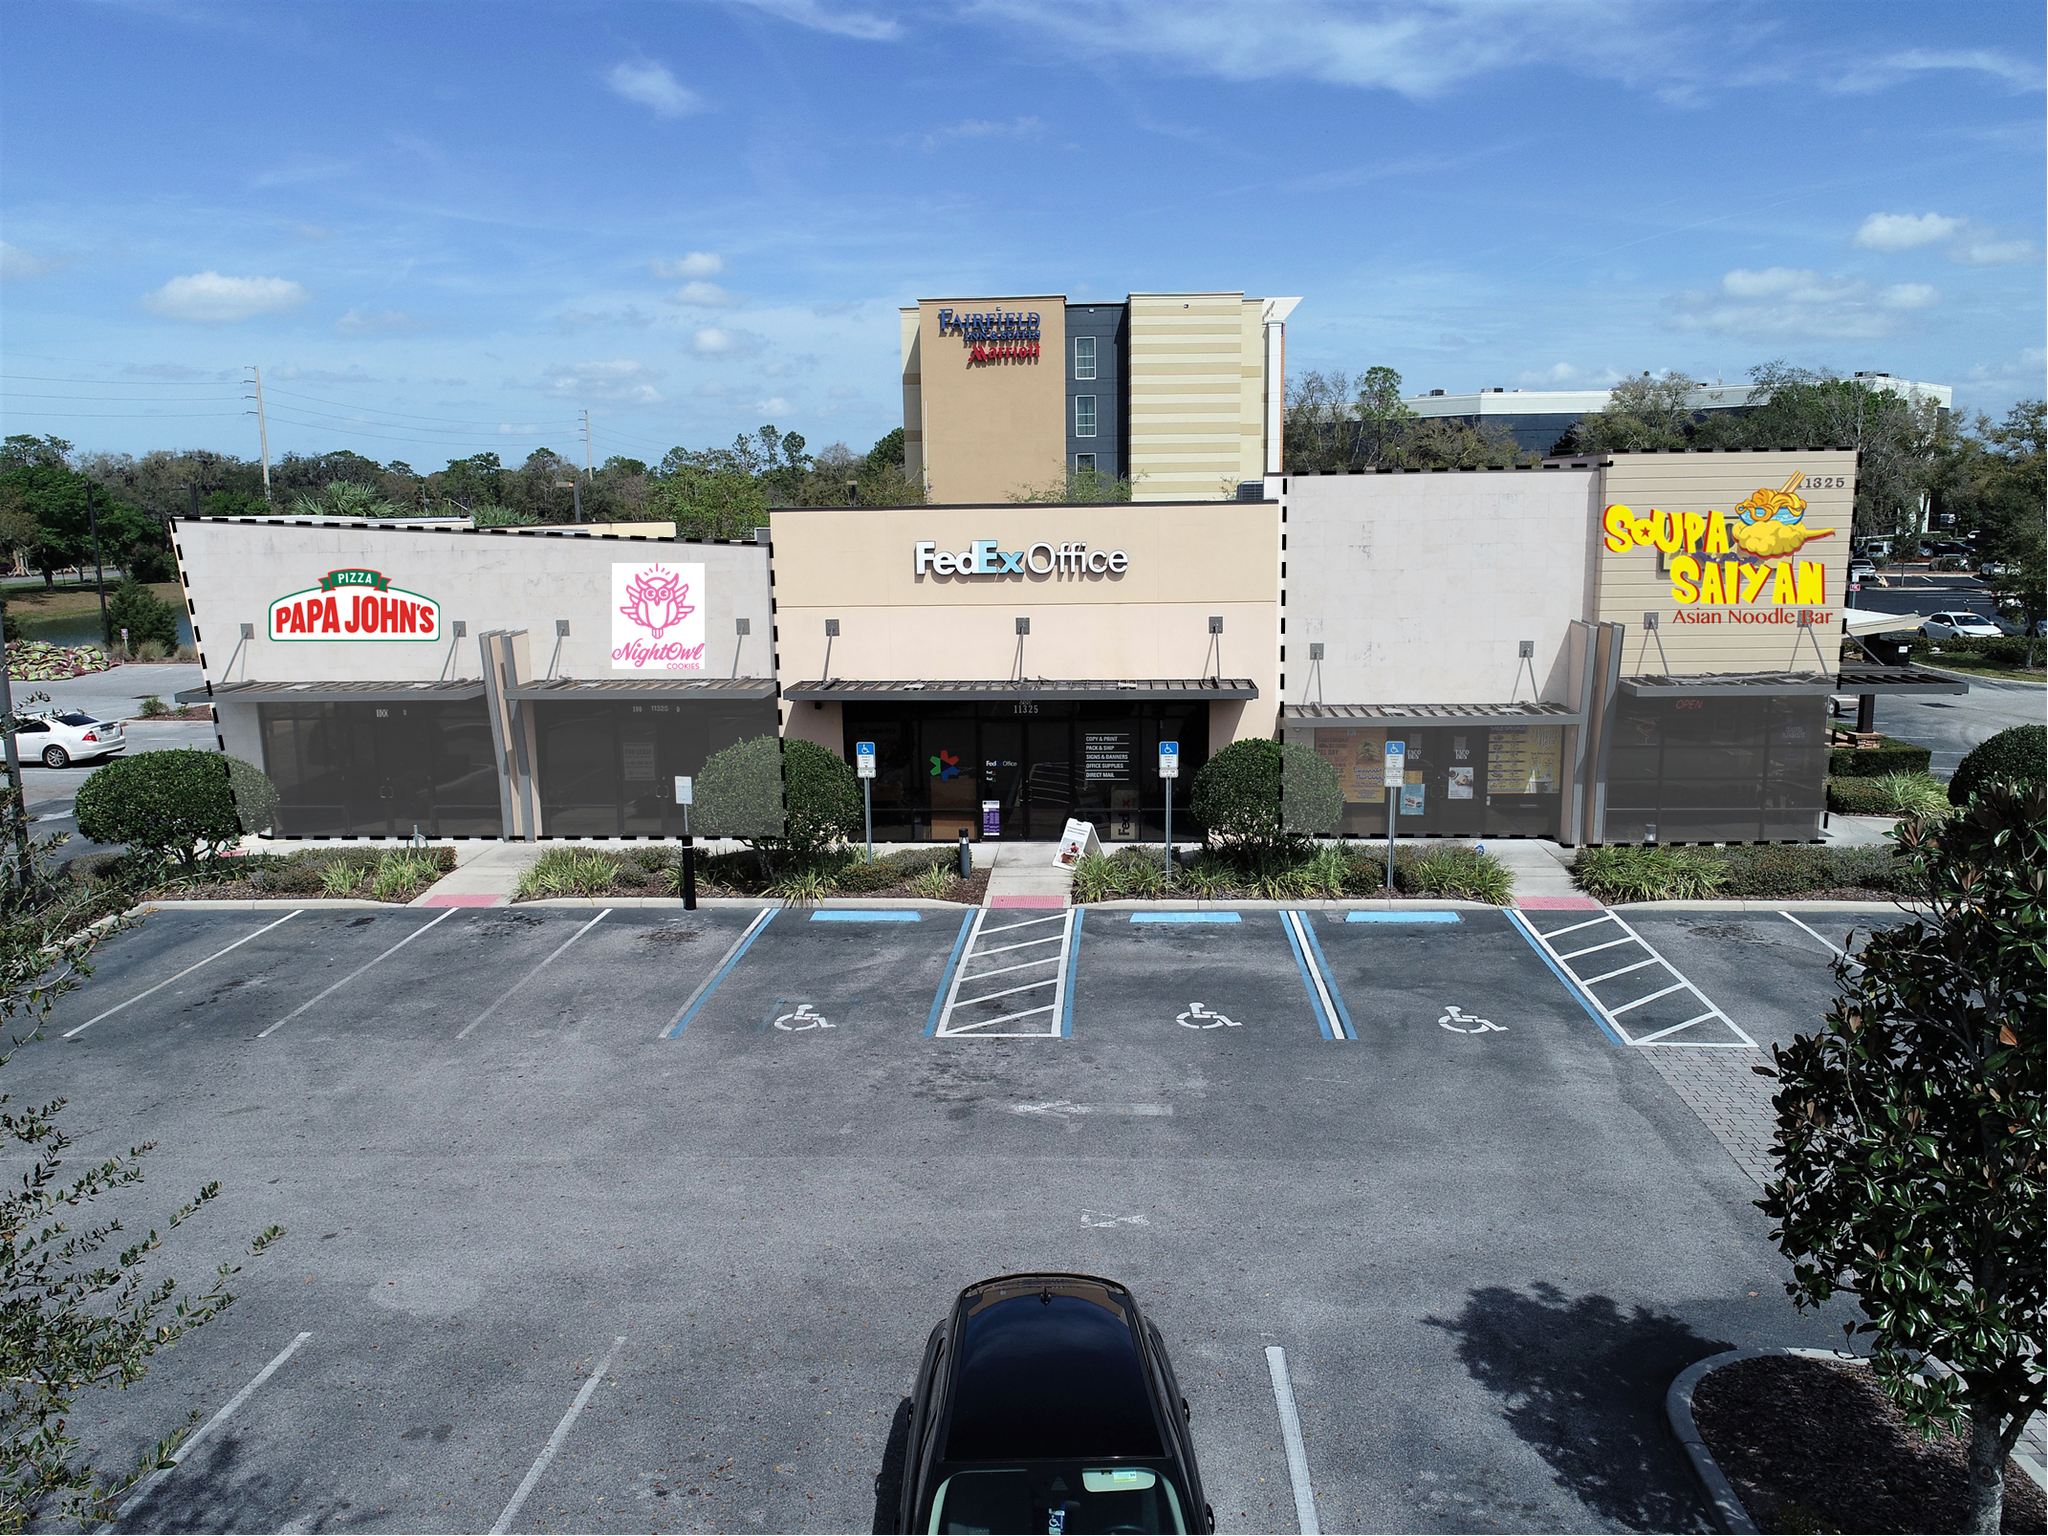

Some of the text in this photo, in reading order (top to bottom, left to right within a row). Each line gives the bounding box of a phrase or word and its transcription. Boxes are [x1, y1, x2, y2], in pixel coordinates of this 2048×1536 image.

[939, 308, 1041, 330] FAIRFIELD
[964, 329, 1041, 341] INN & SUITES
[968, 343, 1041, 362] Marriott
[916, 539, 1129, 576] FedEx Office
[1013, 704, 1039, 714] 11325
[1676, 699, 1704, 710] OPEN
